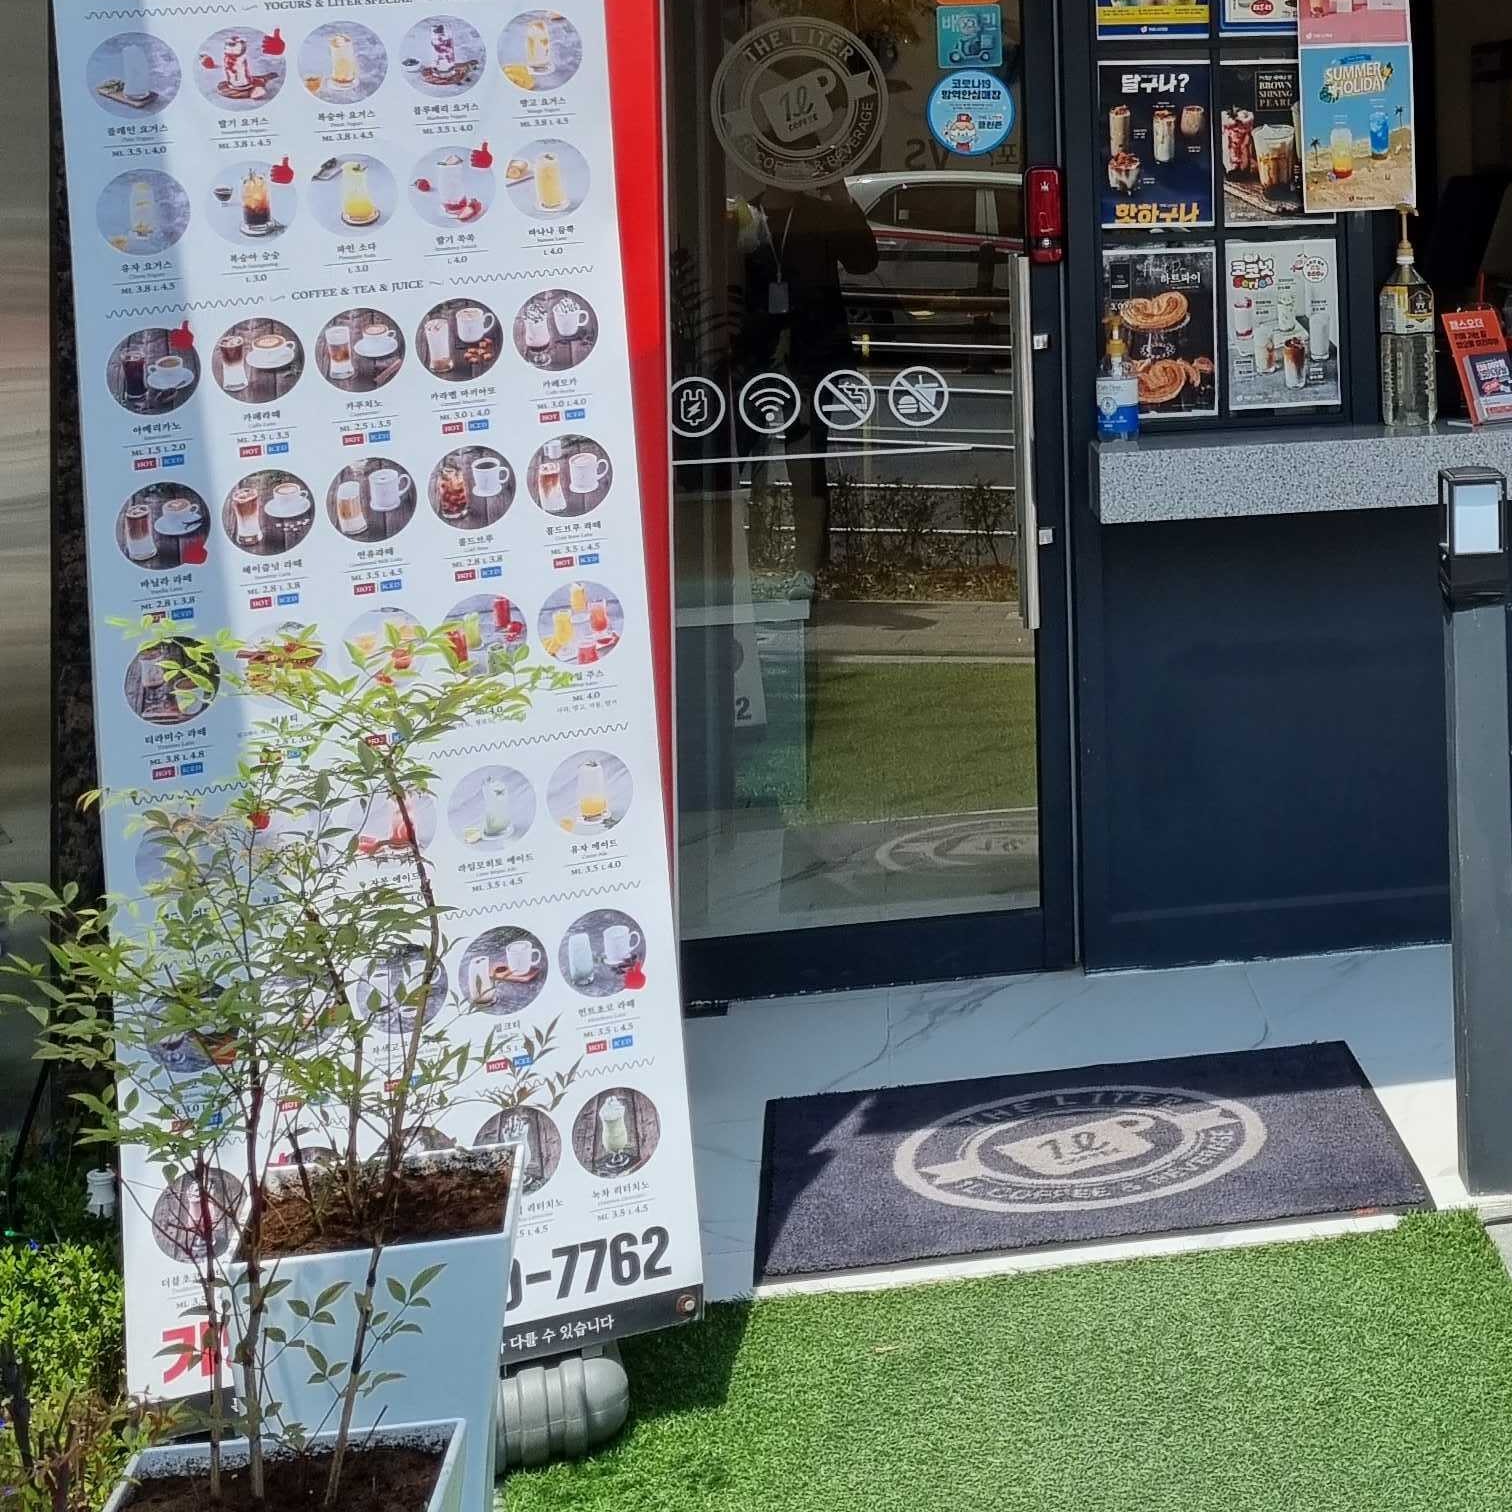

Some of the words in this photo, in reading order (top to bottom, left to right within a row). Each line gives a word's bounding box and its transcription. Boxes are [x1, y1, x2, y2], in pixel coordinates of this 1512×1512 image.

[264, 0, 312, 11] YOGURS
[743, 29, 785, 63] THE
[1326, 62, 1383, 83] SUMMER
[1121, 73, 1190, 93] 달구나?
[1259, 82, 1293, 91] BROWN
[1332, 78, 1386, 98] HOLIDAY
[1259, 90, 1293, 99] SHINING
[1259, 99, 1293, 108] PEARL
[291, 287, 337, 300] COFFEE
[352, 284, 377, 294] TEA
[391, 279, 424, 292] JUICE
[1056, 1089, 1186, 1111] LITER
[1148, 1126, 1237, 1185] BEVERAGE
[542, 1328, 557, 1345] 수
[560, 1314, 615, 1340] 있습니다
